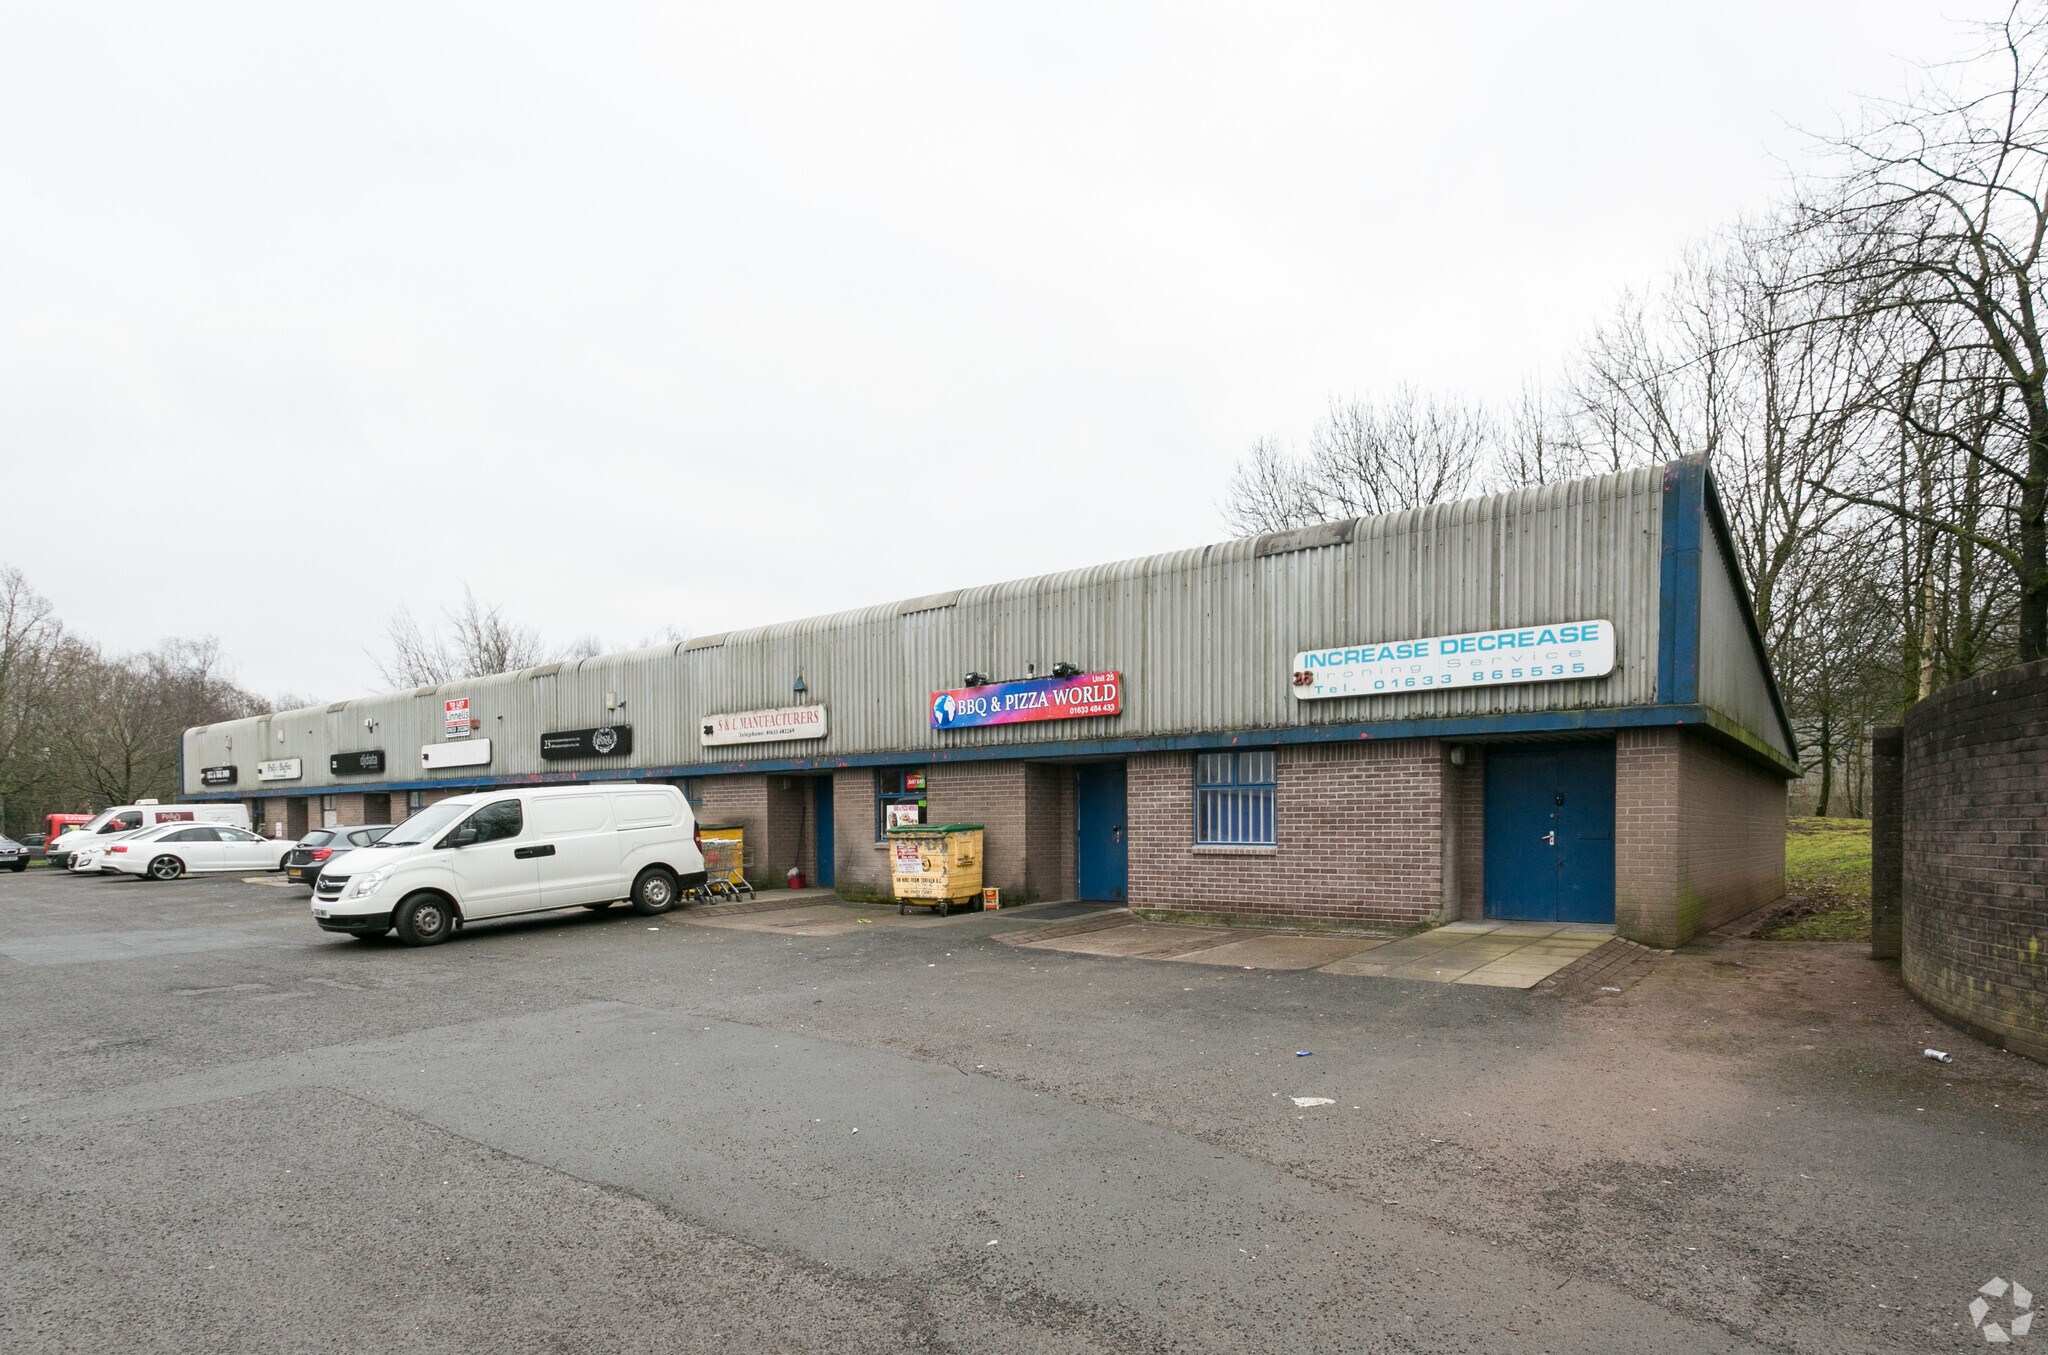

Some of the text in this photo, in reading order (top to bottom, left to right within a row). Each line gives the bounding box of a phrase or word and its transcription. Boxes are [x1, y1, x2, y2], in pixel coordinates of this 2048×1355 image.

[1304, 624, 1600, 669] INCREASE DECREASE
[1315, 650, 1583, 681] Ironing Service
[1092, 674, 1115, 683] Unit 25
[1293, 671, 1314, 686] 26
[1314, 663, 1585, 695] Tel. 01633 865535
[957, 684, 1116, 717] BBQ & PIZZA WORLD
[1070, 703, 1115, 715] 01633 484 433
[718, 710, 819, 731] S & L MANUFACTURERS
[544, 740, 551, 749] 23
[161, 813, 182, 821] Polly's
